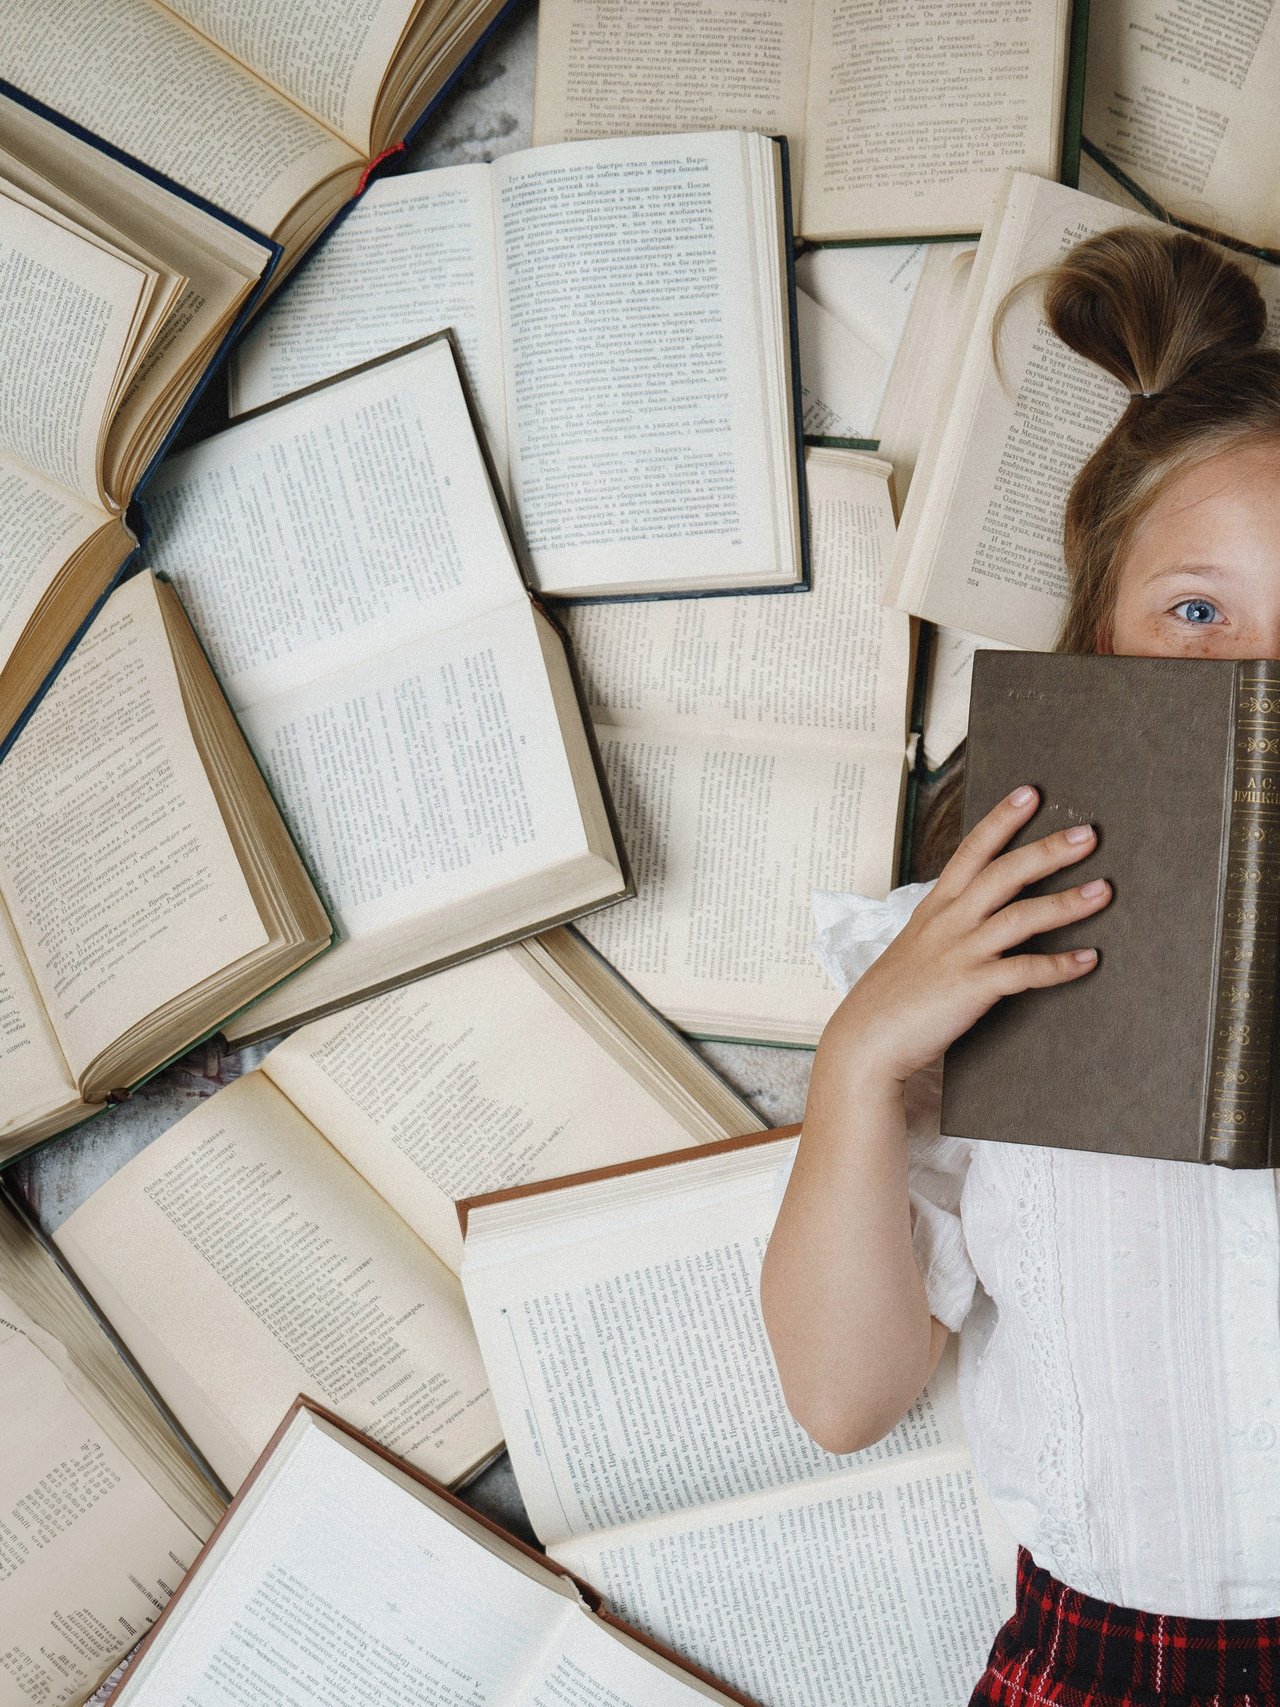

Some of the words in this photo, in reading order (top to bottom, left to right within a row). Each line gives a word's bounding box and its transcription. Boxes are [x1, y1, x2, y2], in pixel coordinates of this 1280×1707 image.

[1048, 358, 1066, 368] пути
[1067, 364, 1099, 379] господин
[1022, 377, 1044, 388] лодой
[1046, 385, 1068, 396] моряк
[1070, 393, 1095, 405] клевал
[1097, 402, 1119, 414] носом,
[1024, 368, 1054, 382] скучные
[1061, 380, 1109, 400] утомительные
[1019, 386, 1049, 400] главном
[1050, 396, 1071, 407] своем
[1072, 403, 1111, 421] сокровище,
[1030, 398, 1051, 410] всего,
[1061, 408, 1081, 418] своей
[1083, 415, 1103, 425] дочке
[1015, 402, 1028, 410] это
[1028, 406, 1053, 418] стоило
[1053, 414, 1067, 424] ему
[1068, 419, 1101, 433] немалого
[1001, 493, 1046, 514] Одиночество
[966, 578, 979, 586] 354
[970, 567, 1002, 580] товилась
[1003, 576, 1028, 588] четыре
